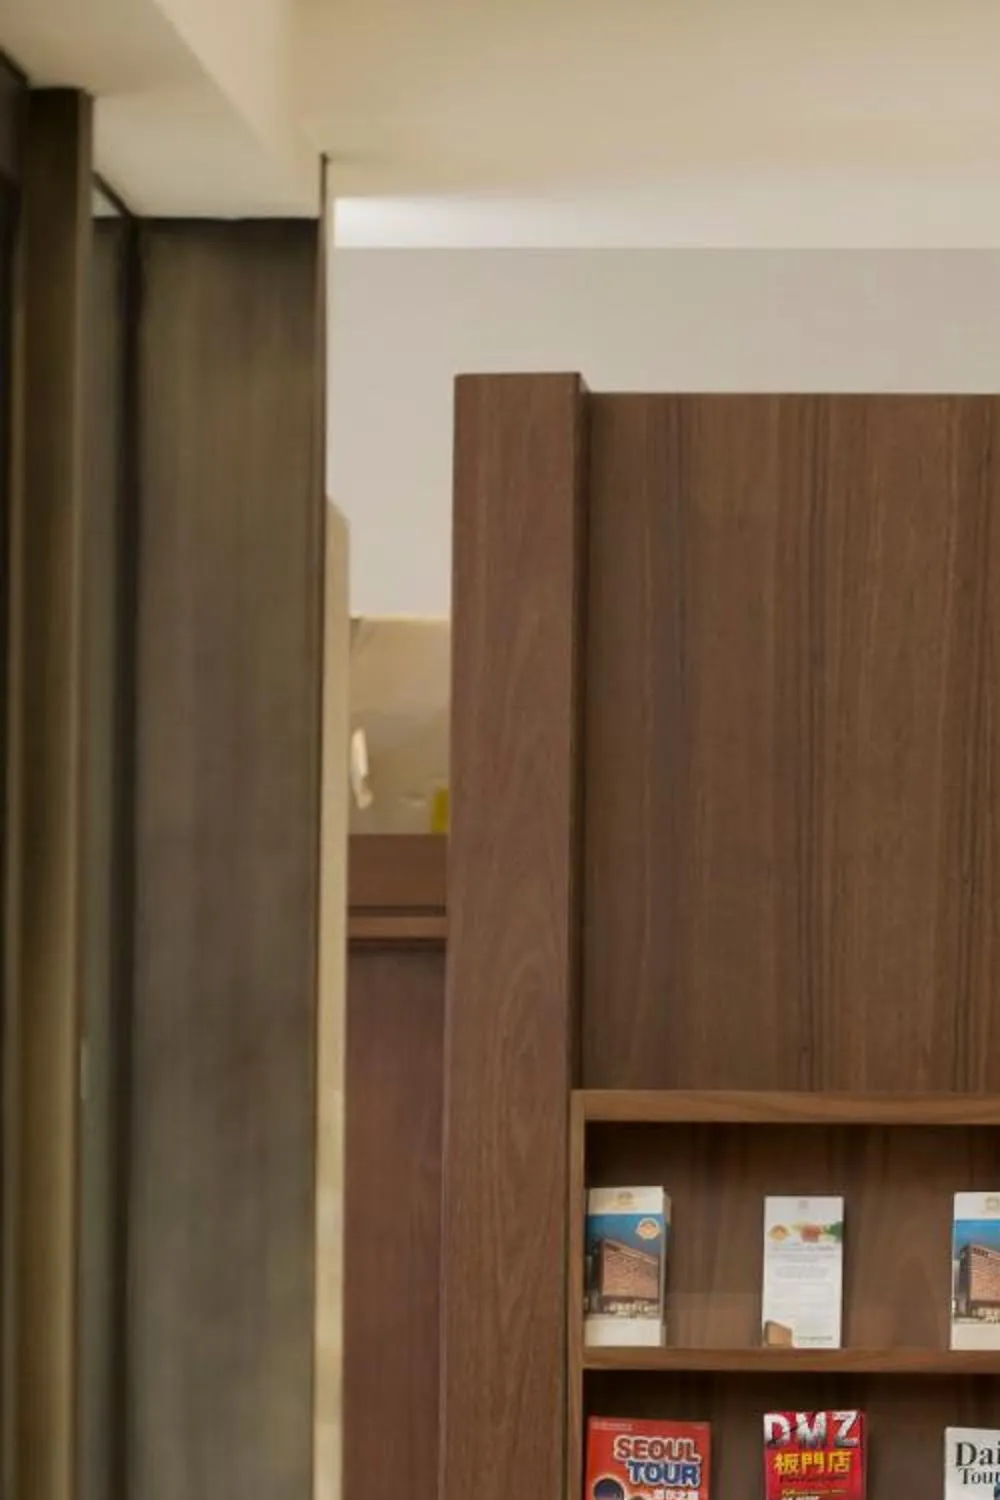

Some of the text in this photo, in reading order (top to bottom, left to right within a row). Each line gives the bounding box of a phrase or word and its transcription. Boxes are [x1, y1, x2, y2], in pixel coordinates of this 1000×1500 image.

[763, 1410, 859, 1448] DMZ
[616, 1436, 701, 1463] SEOUL
[627, 1460, 701, 1487] TOUR
